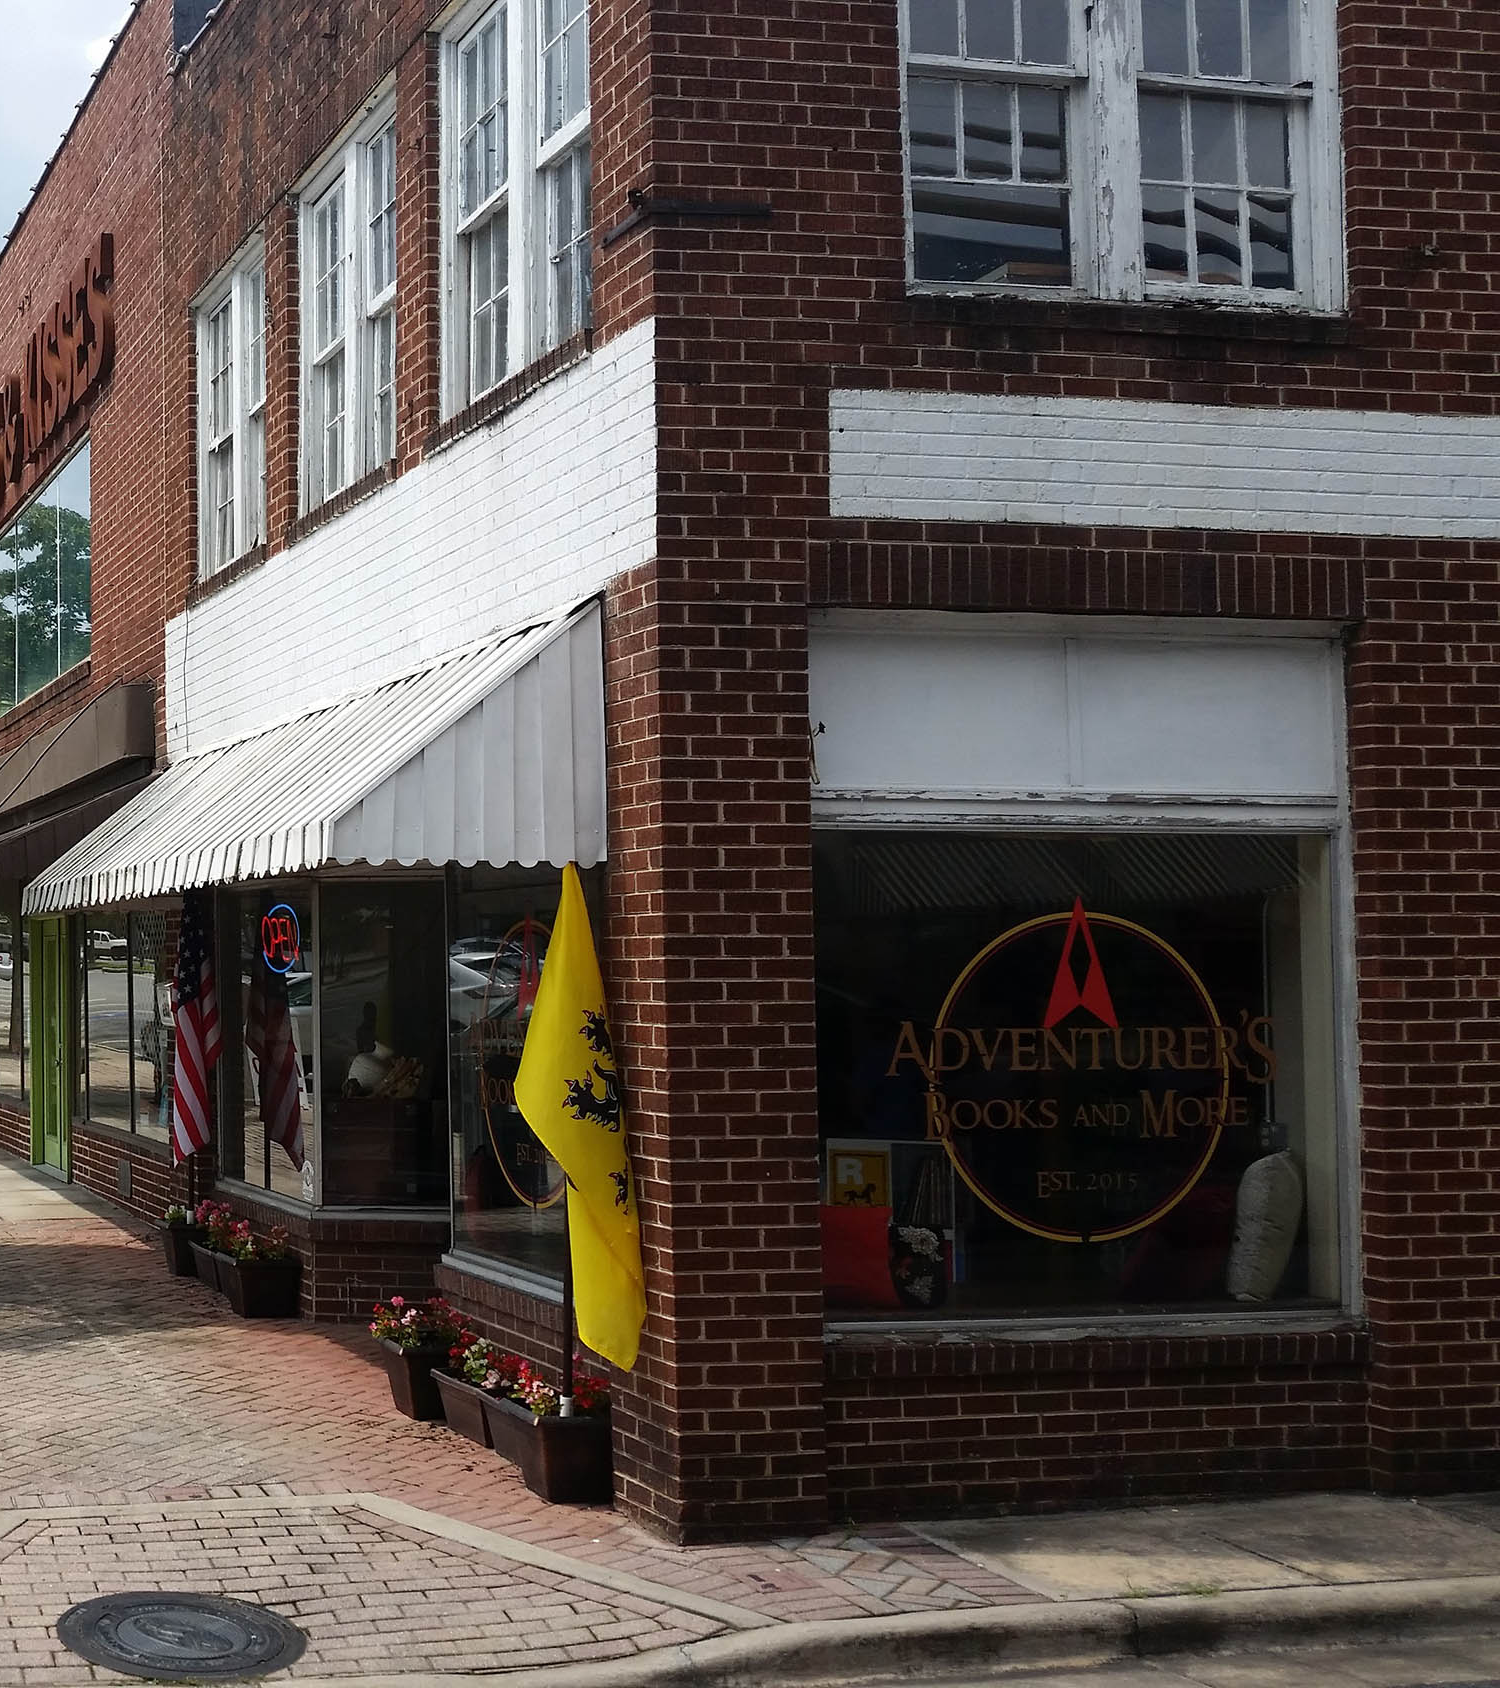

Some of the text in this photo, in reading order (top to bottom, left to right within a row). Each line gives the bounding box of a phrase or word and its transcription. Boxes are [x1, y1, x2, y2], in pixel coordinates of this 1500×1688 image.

[24, 232, 116, 456] KISSES
[262, 916, 299, 962] OPEN
[885, 1009, 1278, 1085] ADVENTURER'S
[924, 1090, 1249, 1140] BOOKS AND MORE
[836, 1158, 863, 1185] R
[1037, 1171, 1139, 1198] EST. 2015
